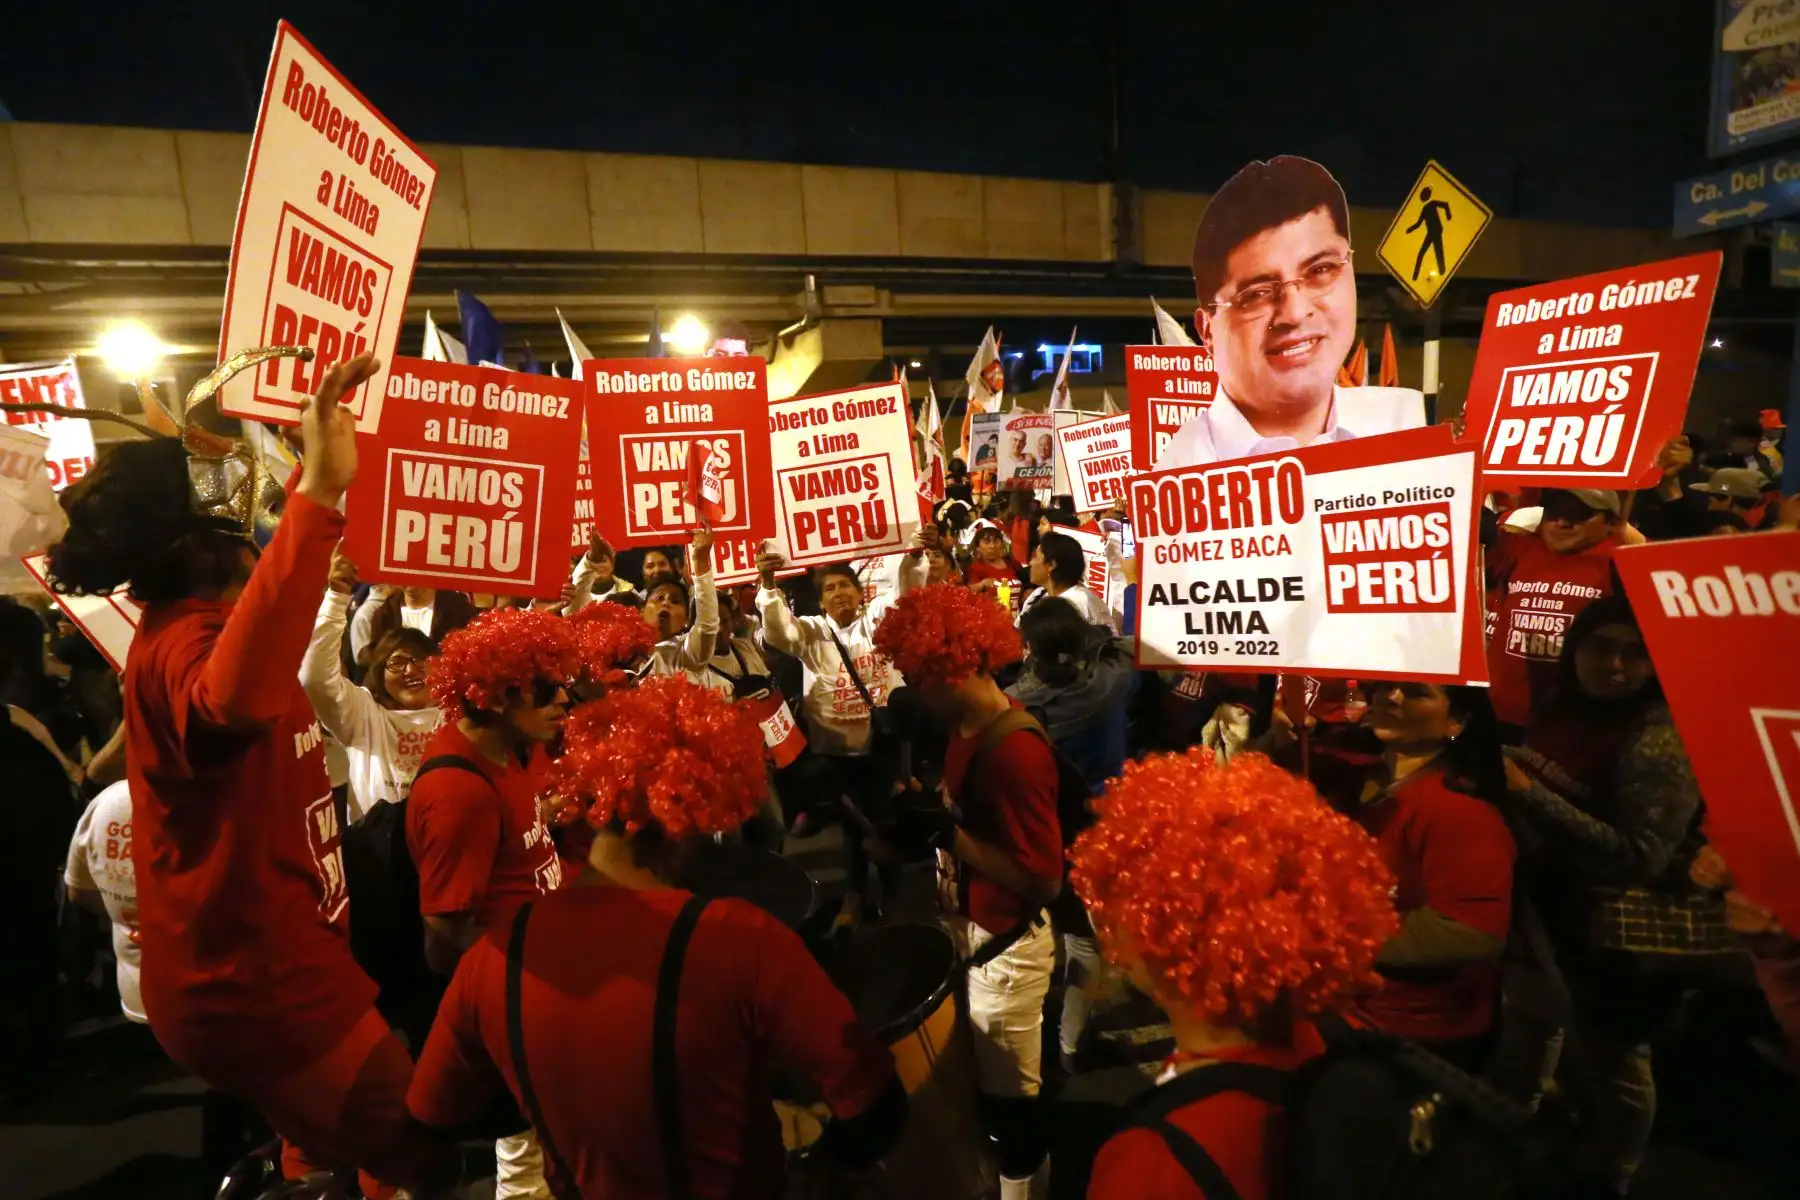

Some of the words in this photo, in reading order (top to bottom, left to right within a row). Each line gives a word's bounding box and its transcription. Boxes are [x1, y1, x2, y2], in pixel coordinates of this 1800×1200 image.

[283, 59, 369, 167] Roberto
[369, 136, 425, 212] Gómez
[1690, 181, 1723, 204] Ca.
[1731, 167, 1766, 194] Del
[317, 169, 334, 207] a
[334, 176, 380, 236] Lima
[286, 227, 377, 318] VAMOS
[1496, 291, 1591, 328] Roberto
[1599, 274, 1700, 311] Gómez
[1538, 336, 1553, 355] a
[1558, 322, 1623, 352] Lima
[1134, 354, 1191, 372] Roberto
[1194, 354, 1216, 372] Gó
[387, 372, 476, 408] oberto
[483, 383, 570, 419] Gómez
[596, 371, 684, 394] Roberto
[687, 367, 756, 391] Gómez
[1165, 381, 1174, 395] a
[1177, 378, 1211, 395] Lima
[1510, 365, 1633, 408] VAMOS
[646, 406, 659, 425] a
[664, 401, 713, 424] Lima
[769, 407, 828, 431] oberto
[832, 395, 897, 423] Gómez
[424, 422, 440, 442] a
[447, 417, 509, 450] Lima
[798, 440, 809, 457] a
[812, 431, 860, 455] Lima
[1064, 426, 1101, 442] Roberto
[1103, 420, 1130, 434] Góme
[1087, 445, 1095, 453] a
[1096, 439, 1118, 451] Lima
[1489, 403, 1625, 466] PERÚ
[632, 439, 731, 472] VAMS
[1084, 455, 1129, 476] VAMOS
[402, 460, 524, 509] VAMOS
[788, 462, 879, 502] VAMOS
[1134, 462, 1305, 538] ROBERTO
[1314, 494, 1377, 512] Partido
[1383, 486, 1456, 506] Político
[793, 493, 888, 551] PERÚ
[1324, 512, 1450, 554] VAMOS
[393, 509, 524, 573] PERÚ
[1155, 538, 1223, 565] GÓMEZ
[1232, 534, 1292, 559] BACA
[1148, 576, 1305, 606] ALCALDE
[1328, 553, 1450, 606] PERÚ
[1552, 582, 1603, 599] Gómez
[1520, 597, 1529, 607] a
[1532, 597, 1564, 610] Lima
[1185, 610, 1269, 635] LIMA
[1514, 613, 1565, 632] VAMOS
[1177, 639, 1218, 655] 2019
[1235, 639, 1279, 655] 2022
